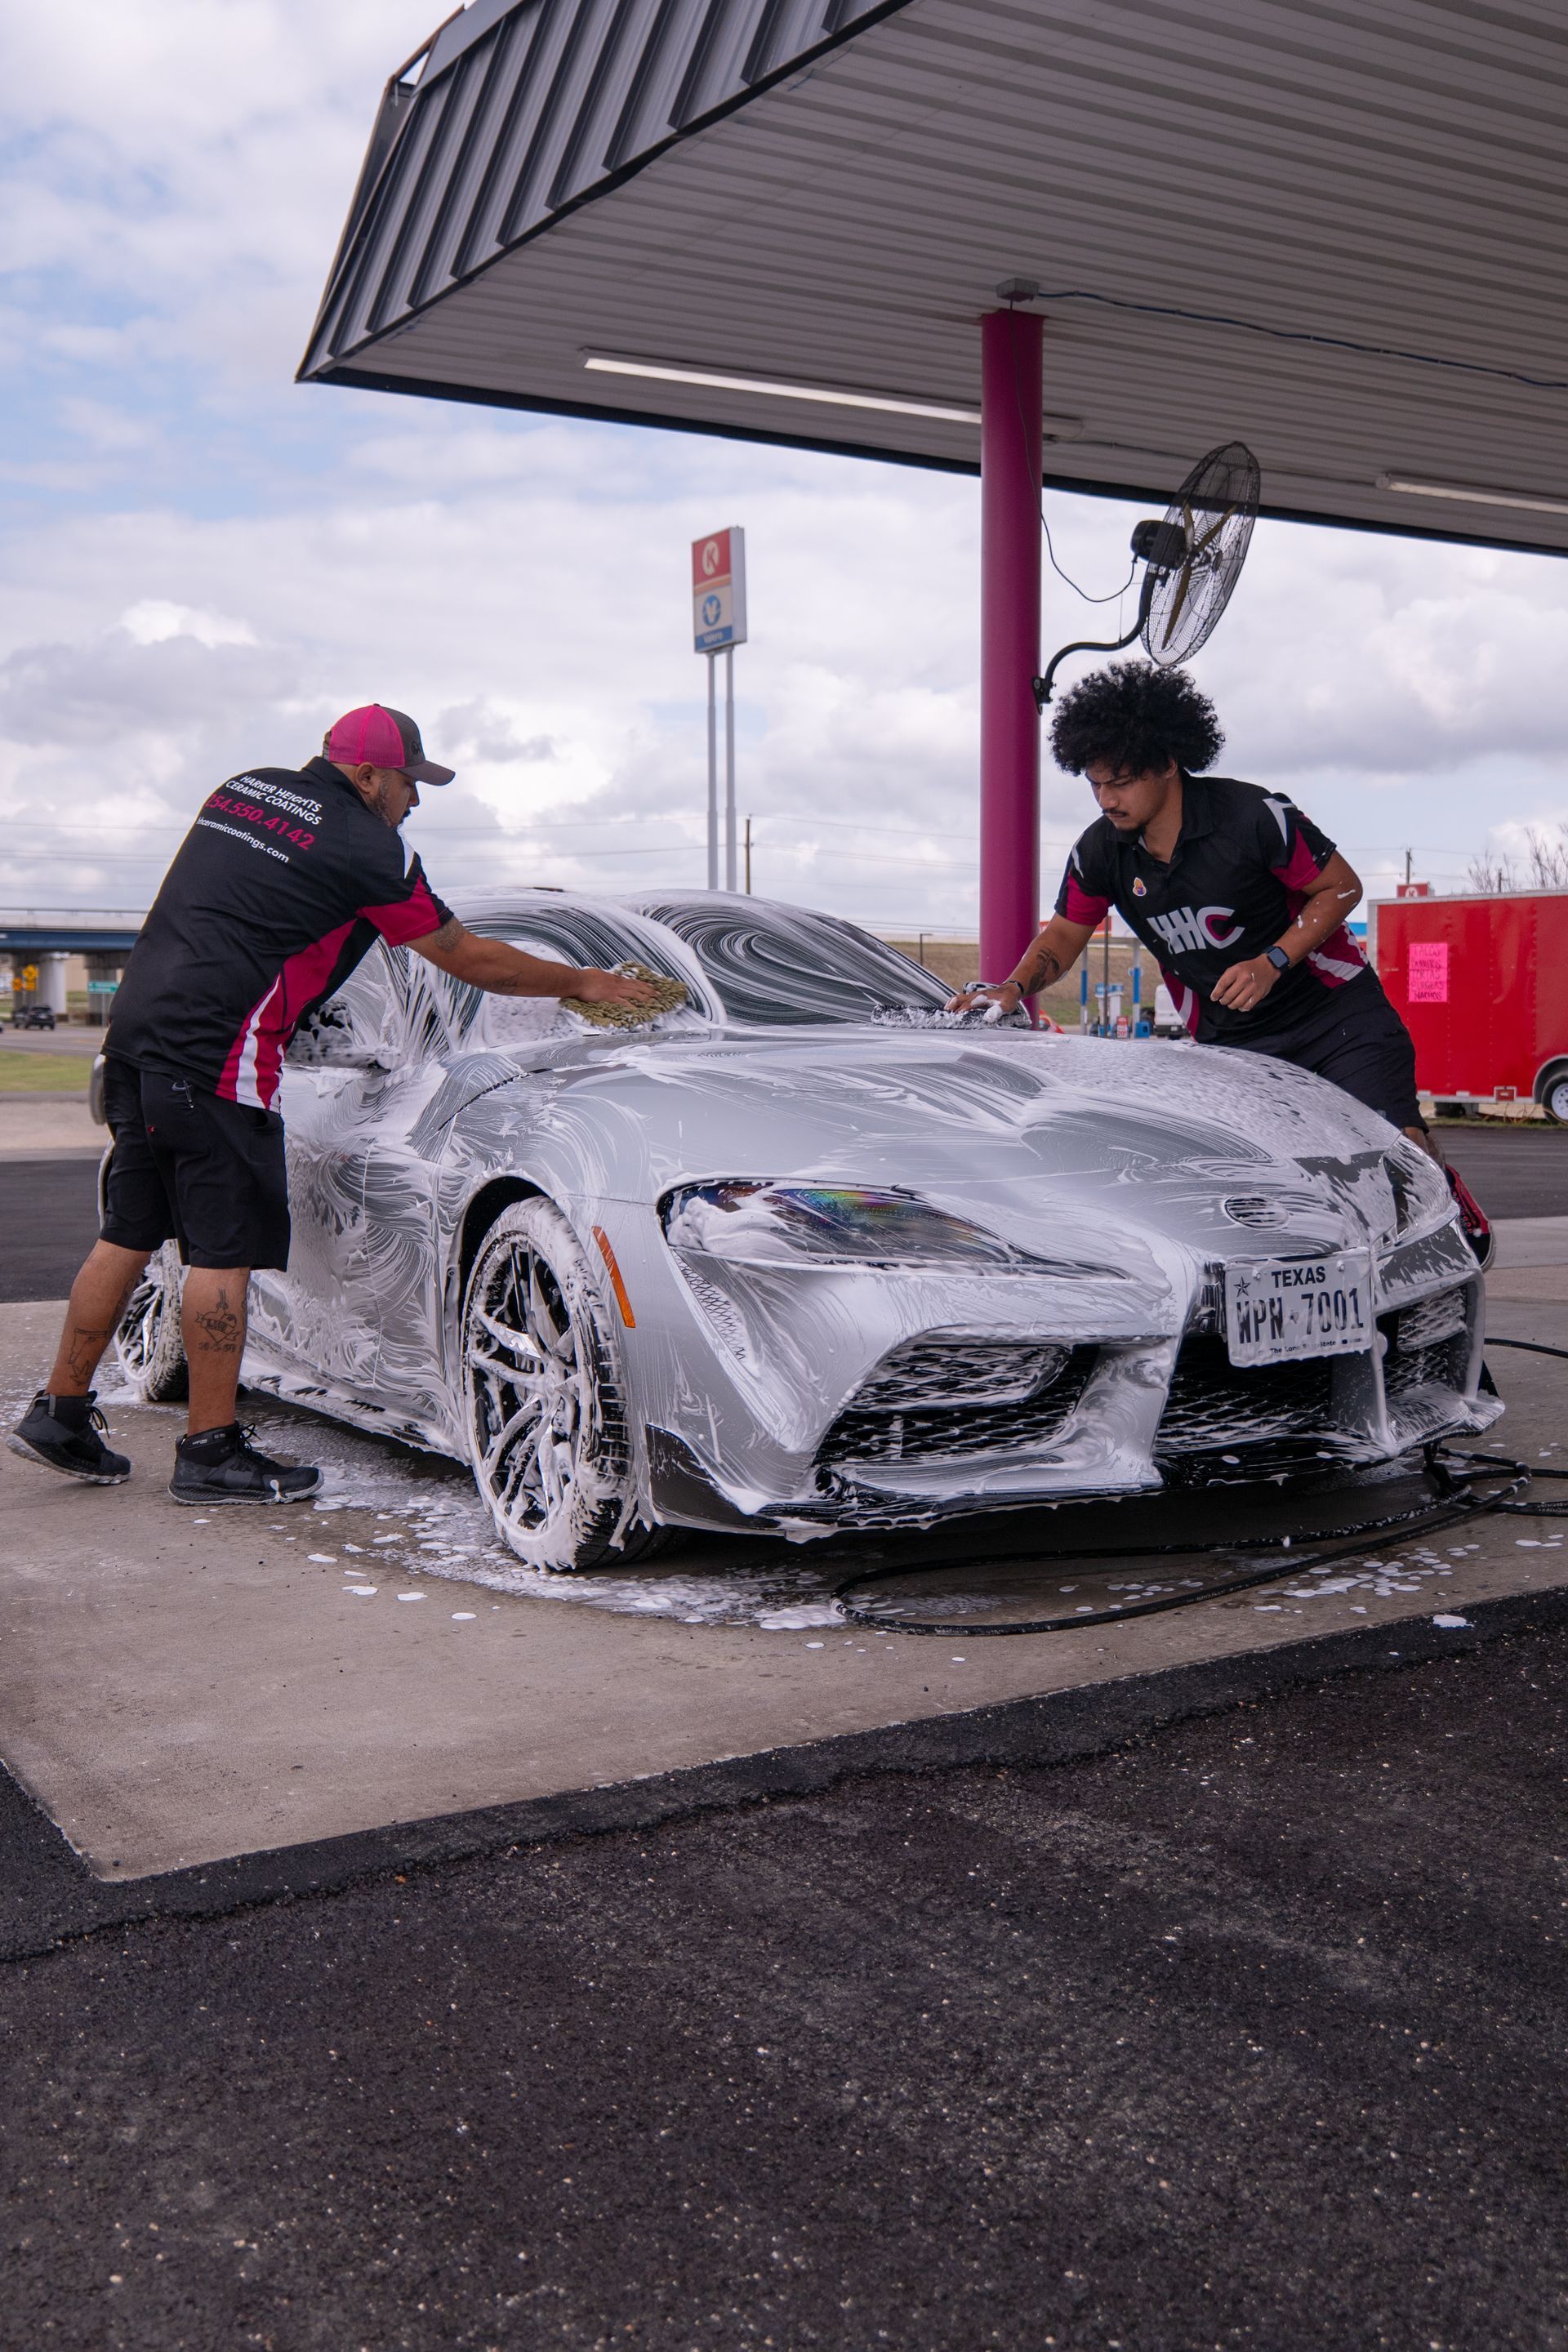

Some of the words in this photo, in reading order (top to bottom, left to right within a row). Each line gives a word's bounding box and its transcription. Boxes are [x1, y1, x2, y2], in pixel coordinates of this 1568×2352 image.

[225, 780, 268, 801] CERAMIC
[264, 795, 323, 826] COATINGS
[240, 775, 278, 795] HARKER
[275, 786, 323, 813] HEIGHTS
[1414, 991, 1442, 1000] NACHOS
[1271, 1266, 1325, 1288] TEXAS
